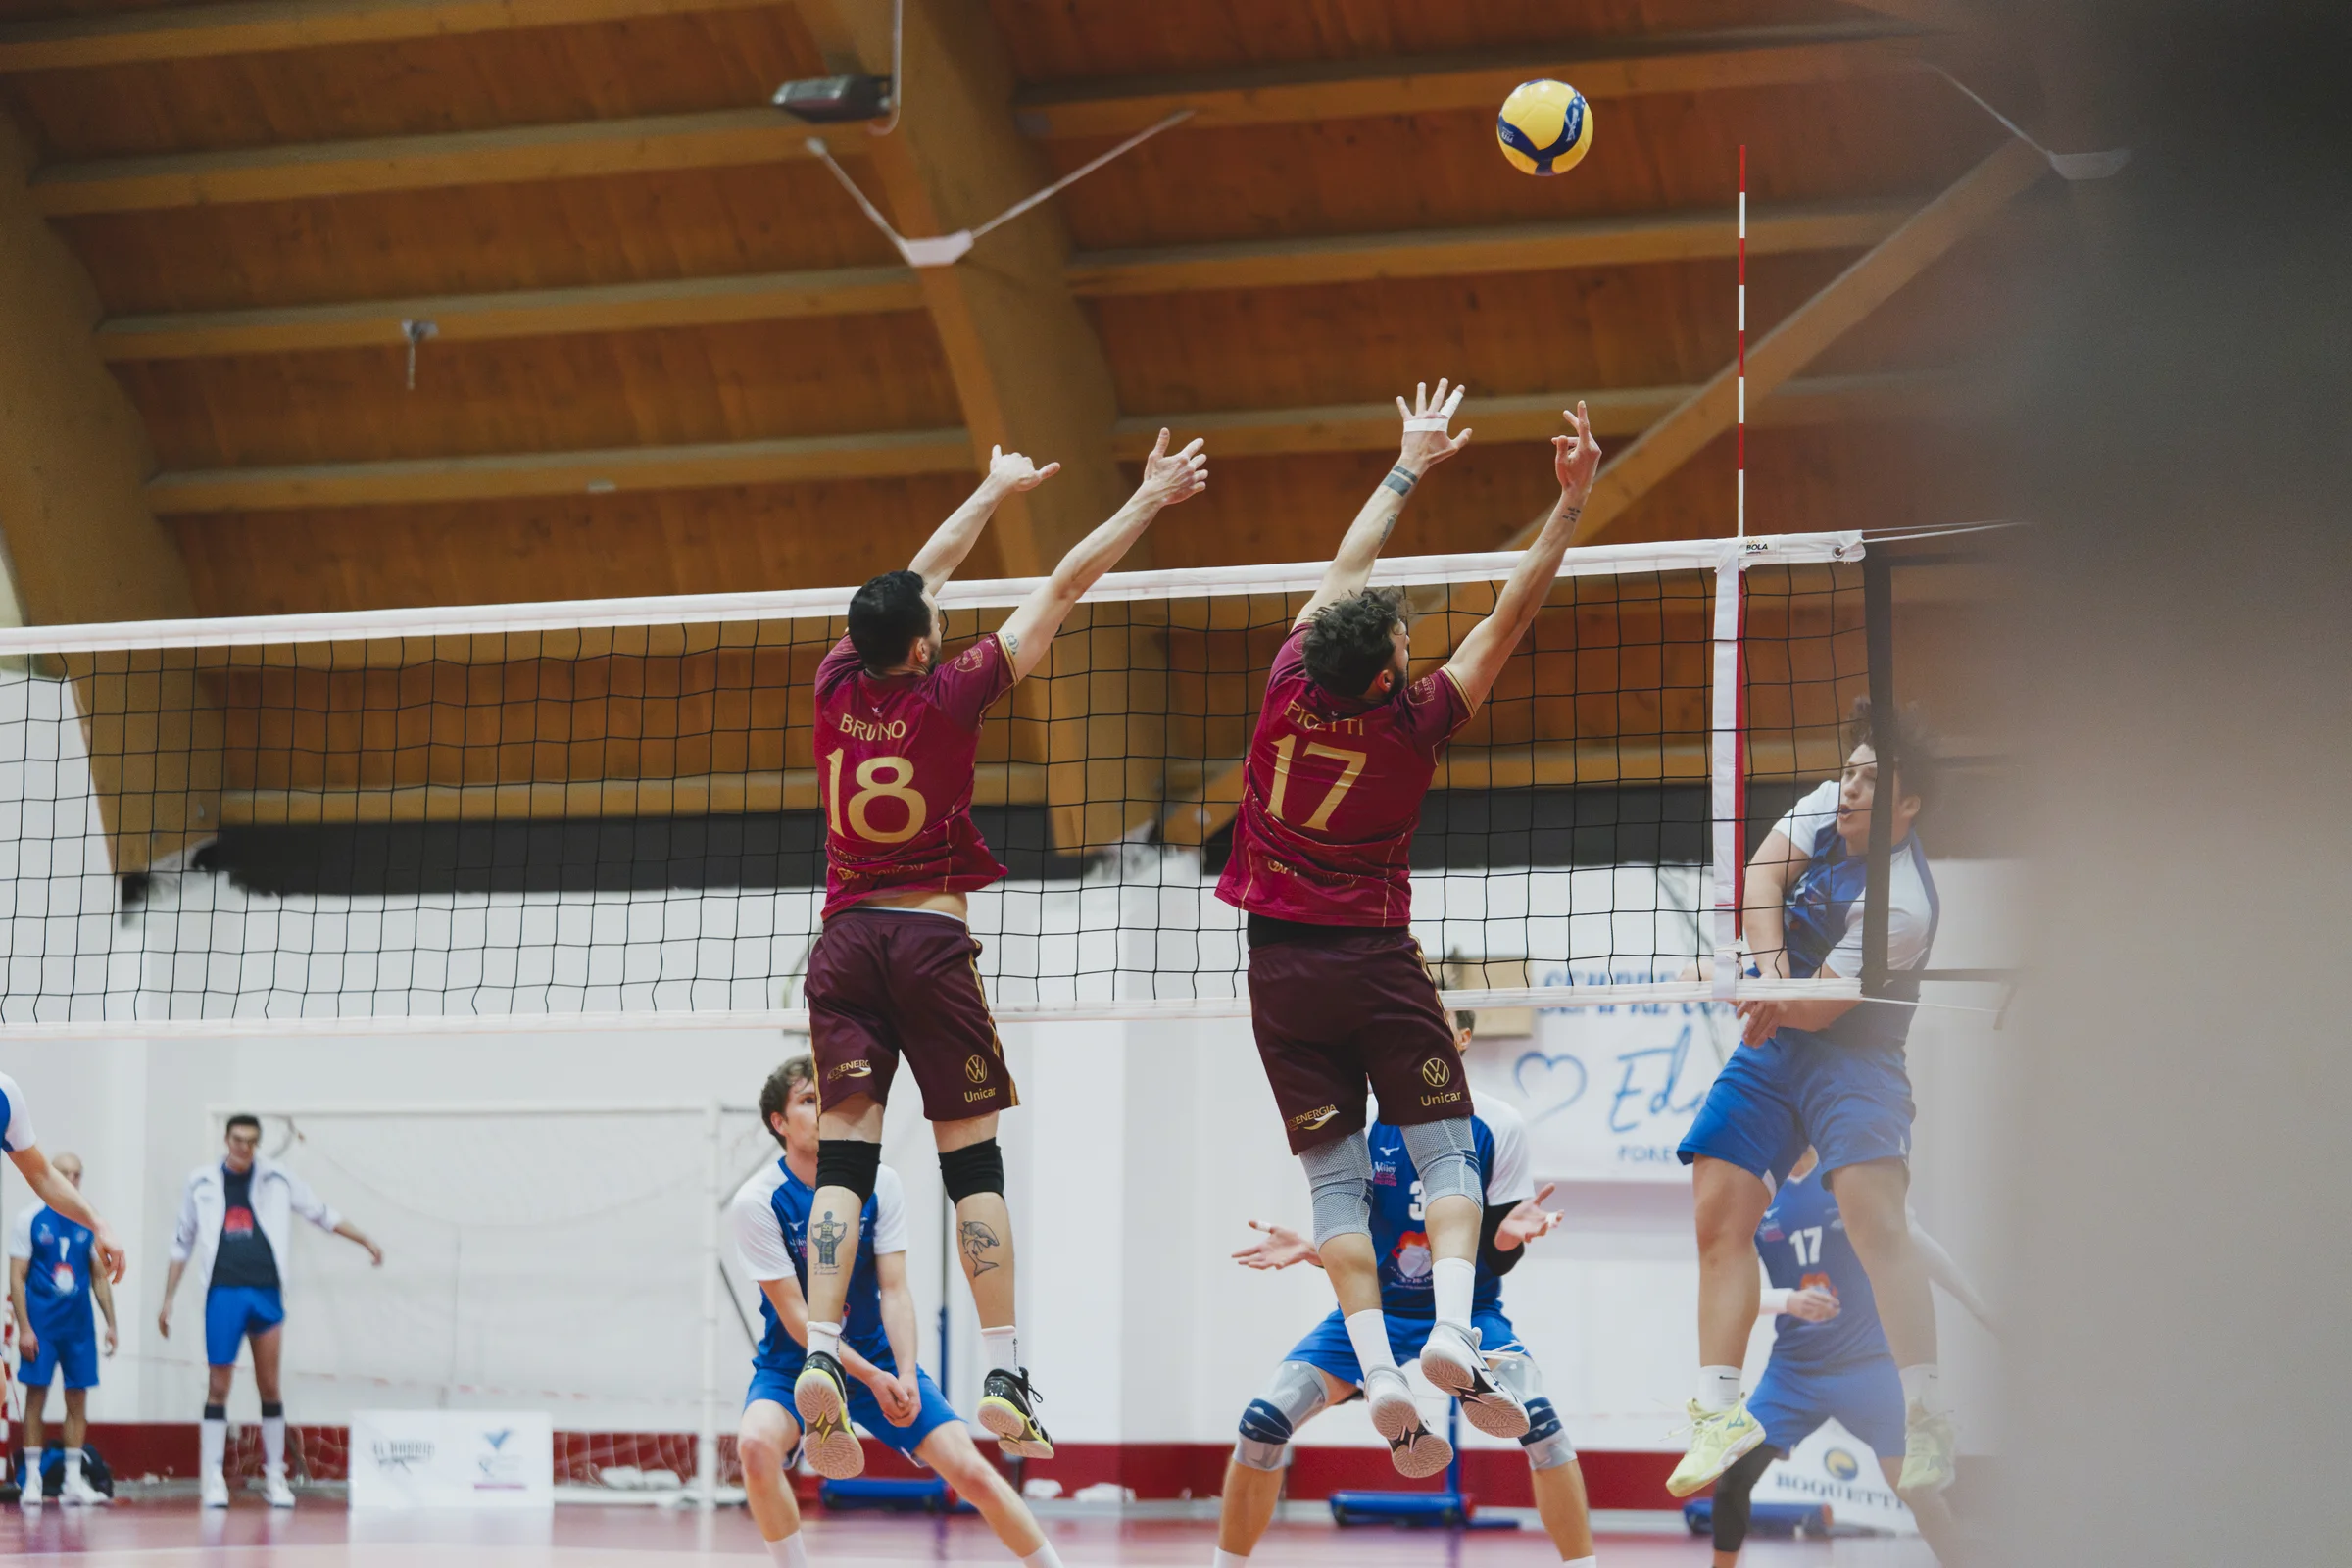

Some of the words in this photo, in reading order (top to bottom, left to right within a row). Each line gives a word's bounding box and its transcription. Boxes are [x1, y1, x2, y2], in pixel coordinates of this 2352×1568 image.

[839, 713, 906, 741] BRUNO
[826, 748, 926, 843] 18
[1266, 734, 1366, 832] 17
[964, 1087, 996, 1102] Unicar
[1421, 1092, 1461, 1106] Unicar
[1618, 1145, 1677, 1163] FORE
[1408, 1180, 1427, 1221] 3
[1788, 1225, 1823, 1268] 17
